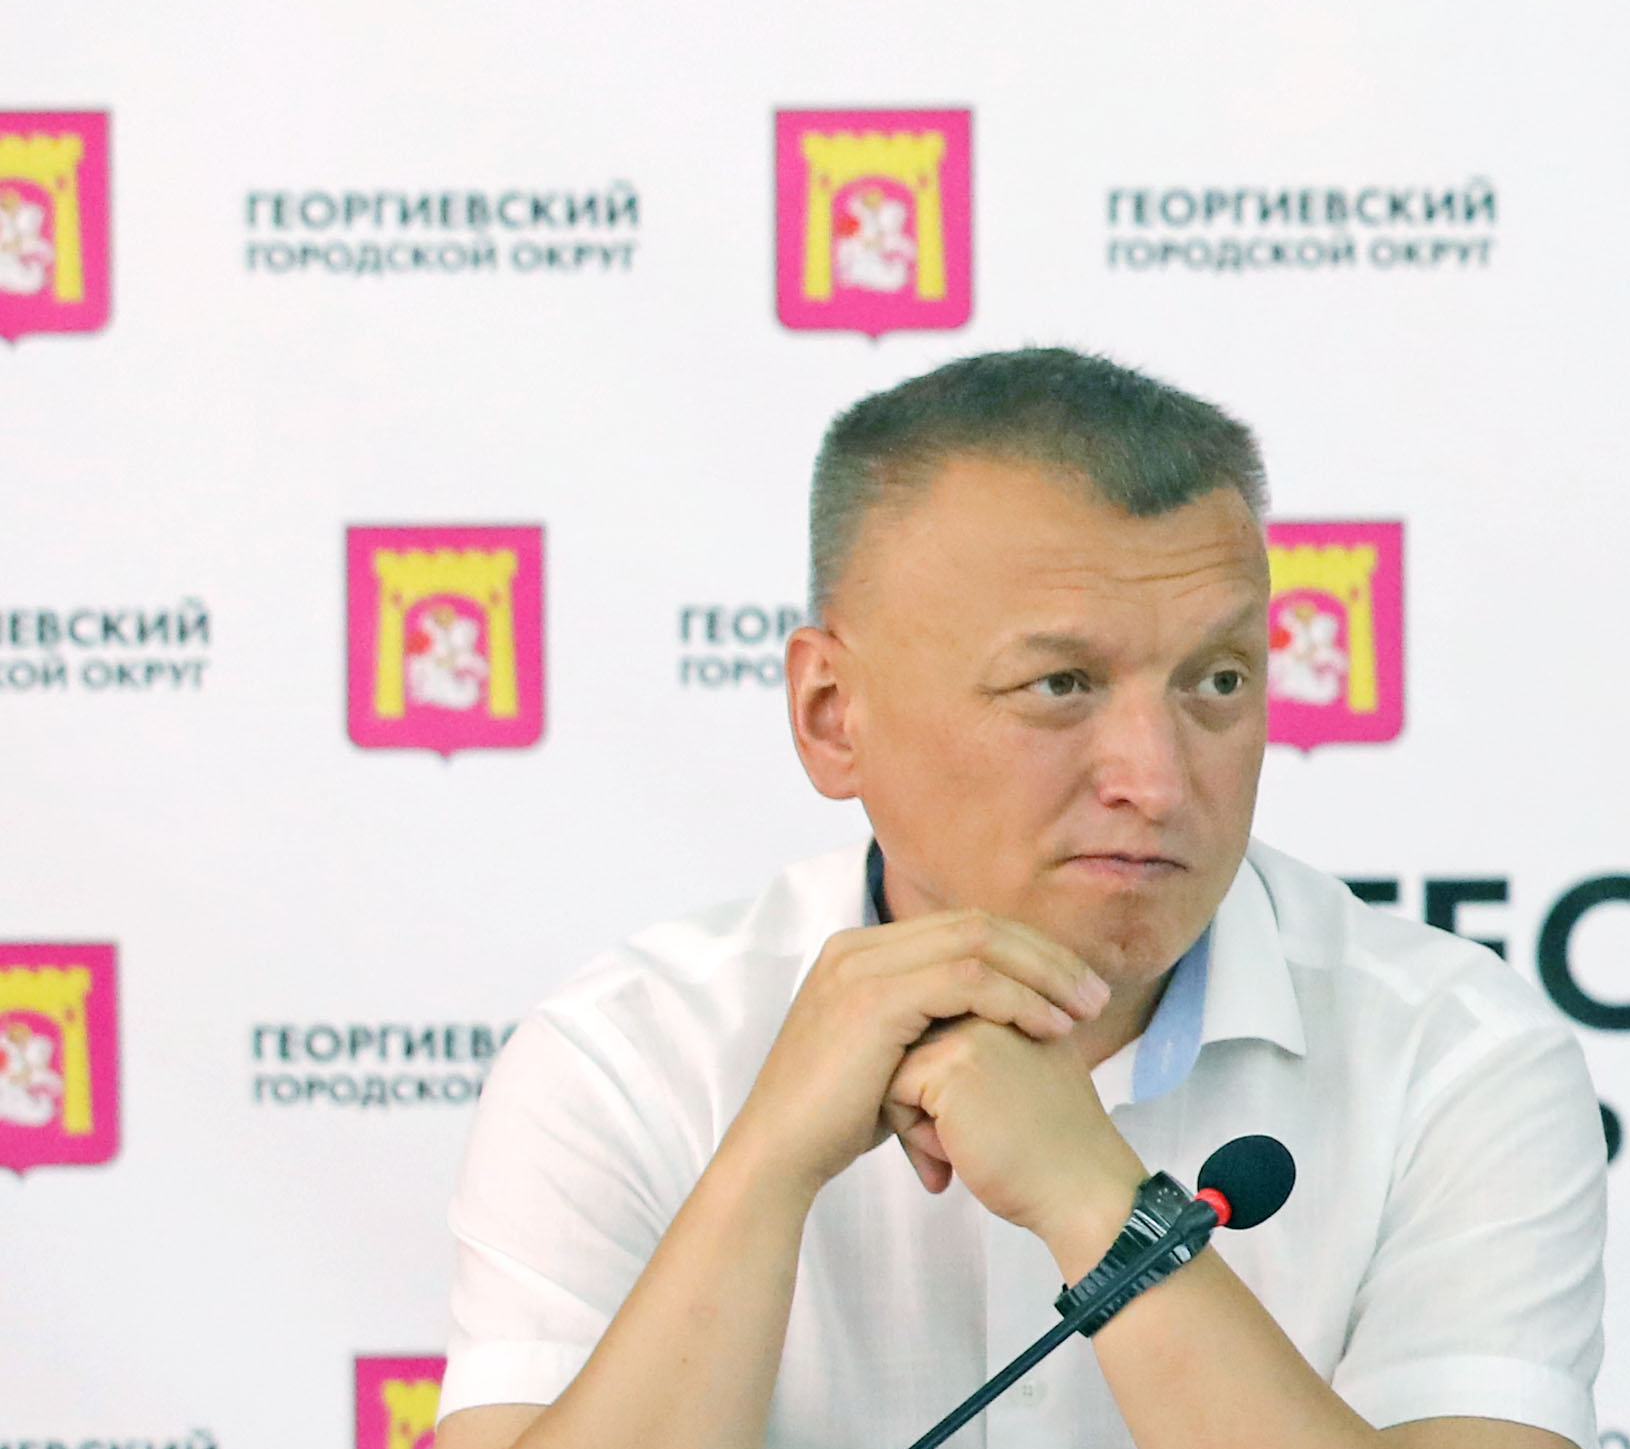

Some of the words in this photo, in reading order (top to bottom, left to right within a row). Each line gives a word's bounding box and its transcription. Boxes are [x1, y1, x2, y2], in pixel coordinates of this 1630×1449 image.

[246, 181, 640, 232] ГЕОРГИЕВСКИЙ
[1107, 178, 1497, 229] ГЕОРГИЕВСКИЙ
[246, 240, 497, 275] ГОРОДСКОЙ
[510, 242, 634, 272] ОКРУГ
[1107, 235, 1356, 272] ГОРОДСКОЙ
[1368, 238, 1492, 268] ОКРУГ
[0, 598, 210, 649] ЕВСКИЙ
[80, 660, 205, 690] ОКРУГ
[251, 1021, 518, 1063] ГЕОРГИЕВ
[252, 1071, 485, 1108] ГОРОДСКО
